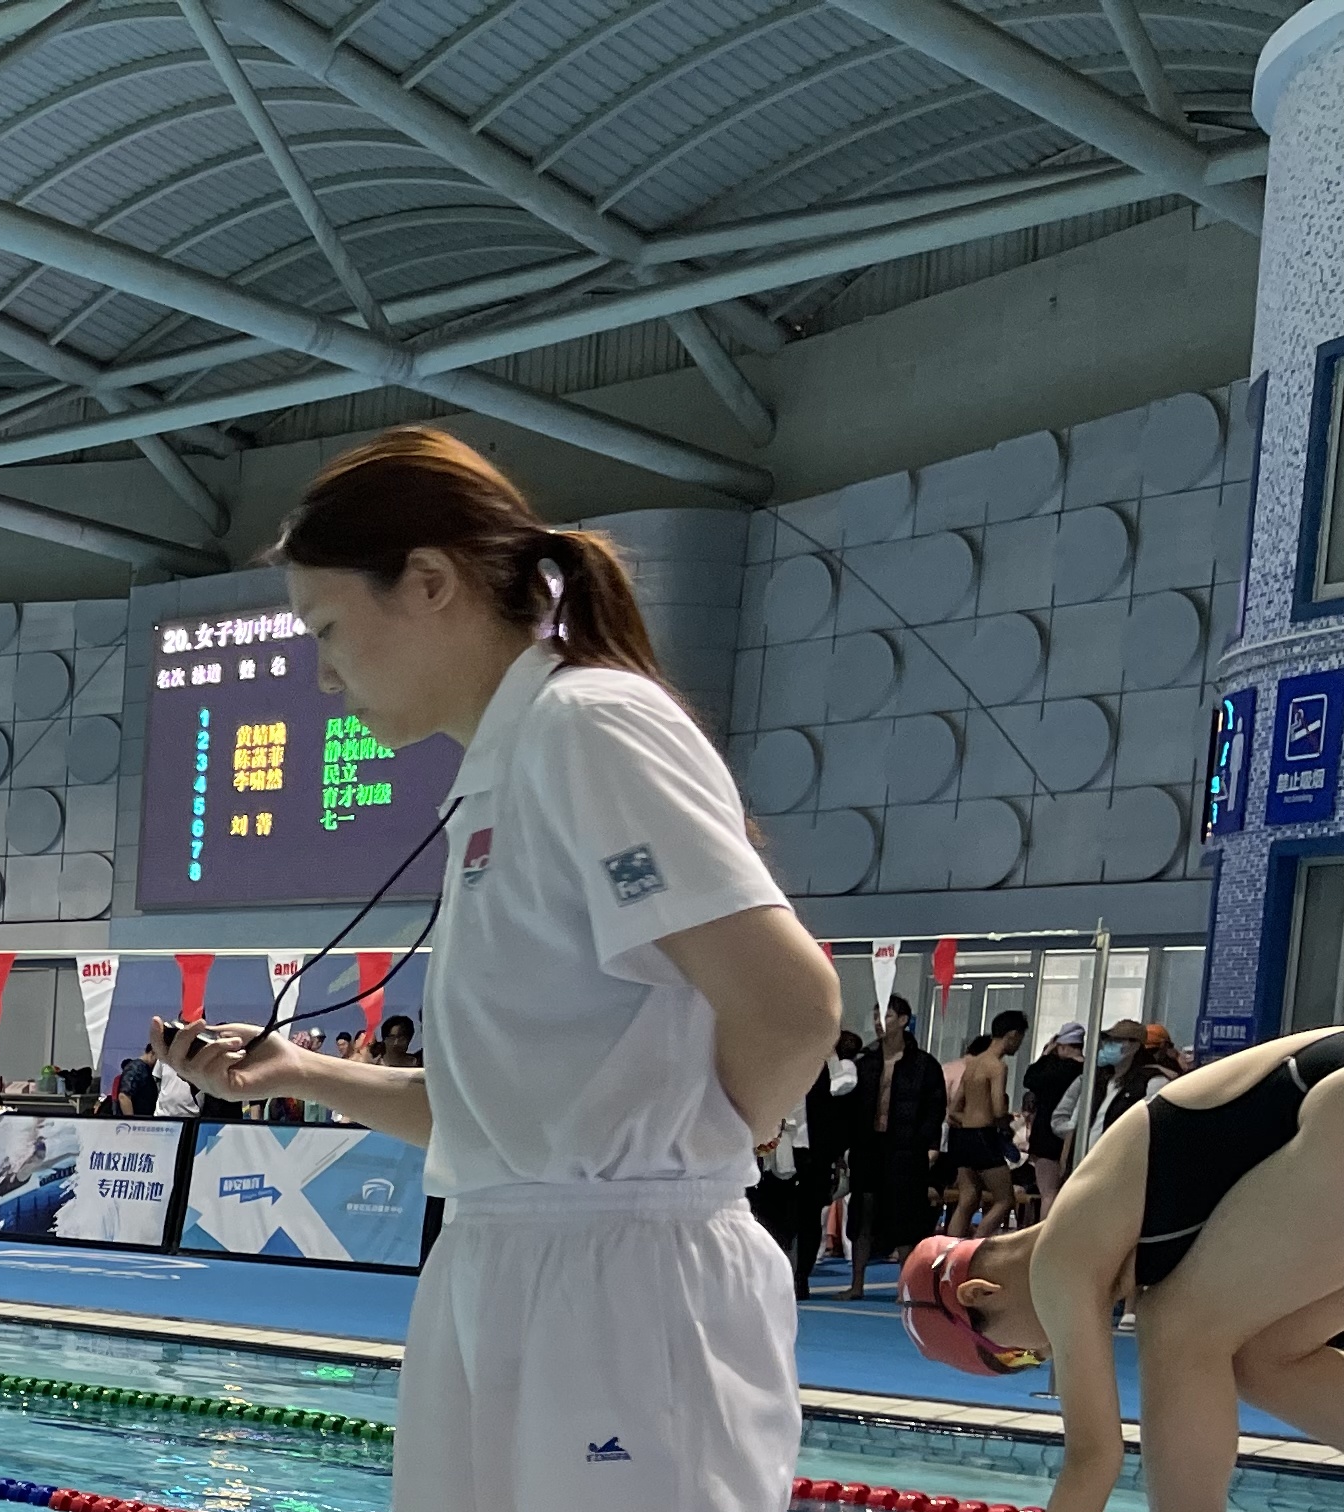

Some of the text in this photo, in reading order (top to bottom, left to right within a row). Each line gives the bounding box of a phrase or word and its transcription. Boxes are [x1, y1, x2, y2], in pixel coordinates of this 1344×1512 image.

[199, 708, 210, 728] 1
[325, 715, 370, 739] 风华
[196, 730, 209, 750] 2
[196, 752, 208, 772] 3
[193, 774, 207, 793] 4
[323, 763, 358, 786] 民立
[192, 795, 205, 815] 5
[323, 783, 392, 809] 育才初级
[191, 818, 205, 837] 6
[320, 810, 355, 831] 七一
[191, 839, 204, 859] 7
[82, 959, 111, 978] anti
[274, 960, 298, 976] anti
[89, 1150, 156, 1174] 体校训练
[97, 1178, 165, 1202] 专用泳池
